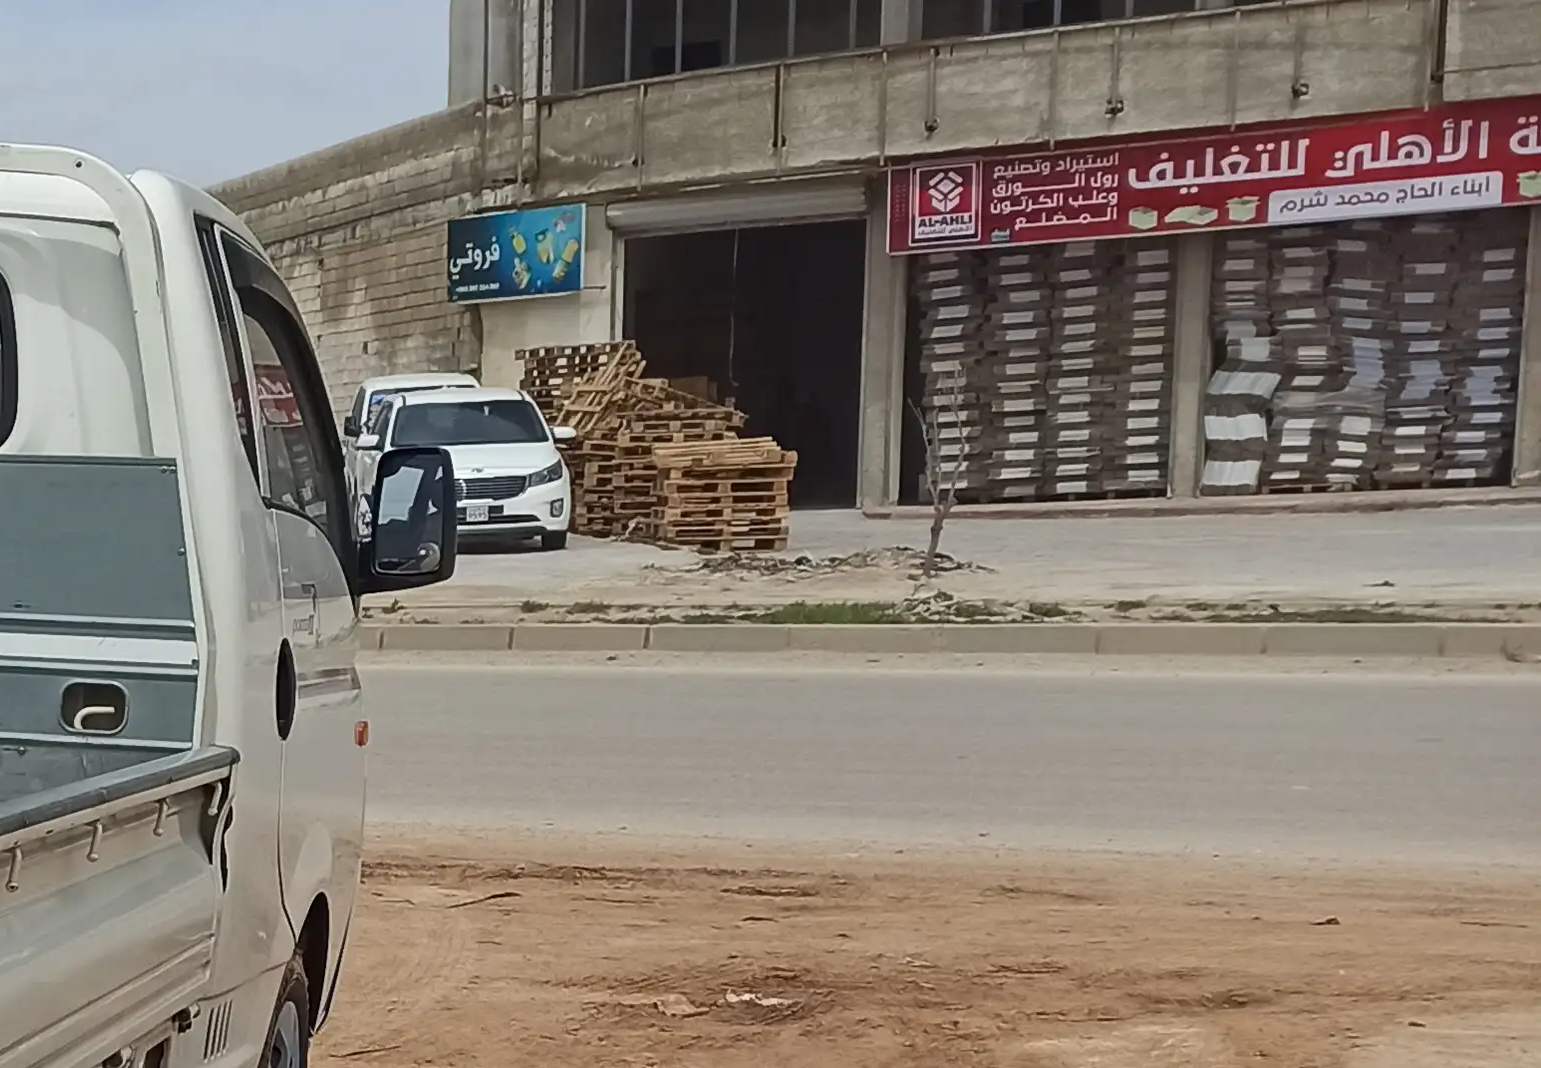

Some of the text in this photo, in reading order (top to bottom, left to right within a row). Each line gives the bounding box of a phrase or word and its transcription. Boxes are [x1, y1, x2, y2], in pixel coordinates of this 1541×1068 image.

[993, 152, 1119, 179] استيراد وتصنيع
[1128, 138, 1310, 195] للتغليف
[1091, 171, 1118, 188] رول
[991, 190, 1118, 214] وعلب الكرتون
[1334, 191, 1389, 206] محمد
[1395, 181, 1444, 203] الحاج
[918, 215, 973, 228] AL-AHLI
[1015, 207, 1118, 231] المضلع
[449, 235, 501, 280] فروتي
